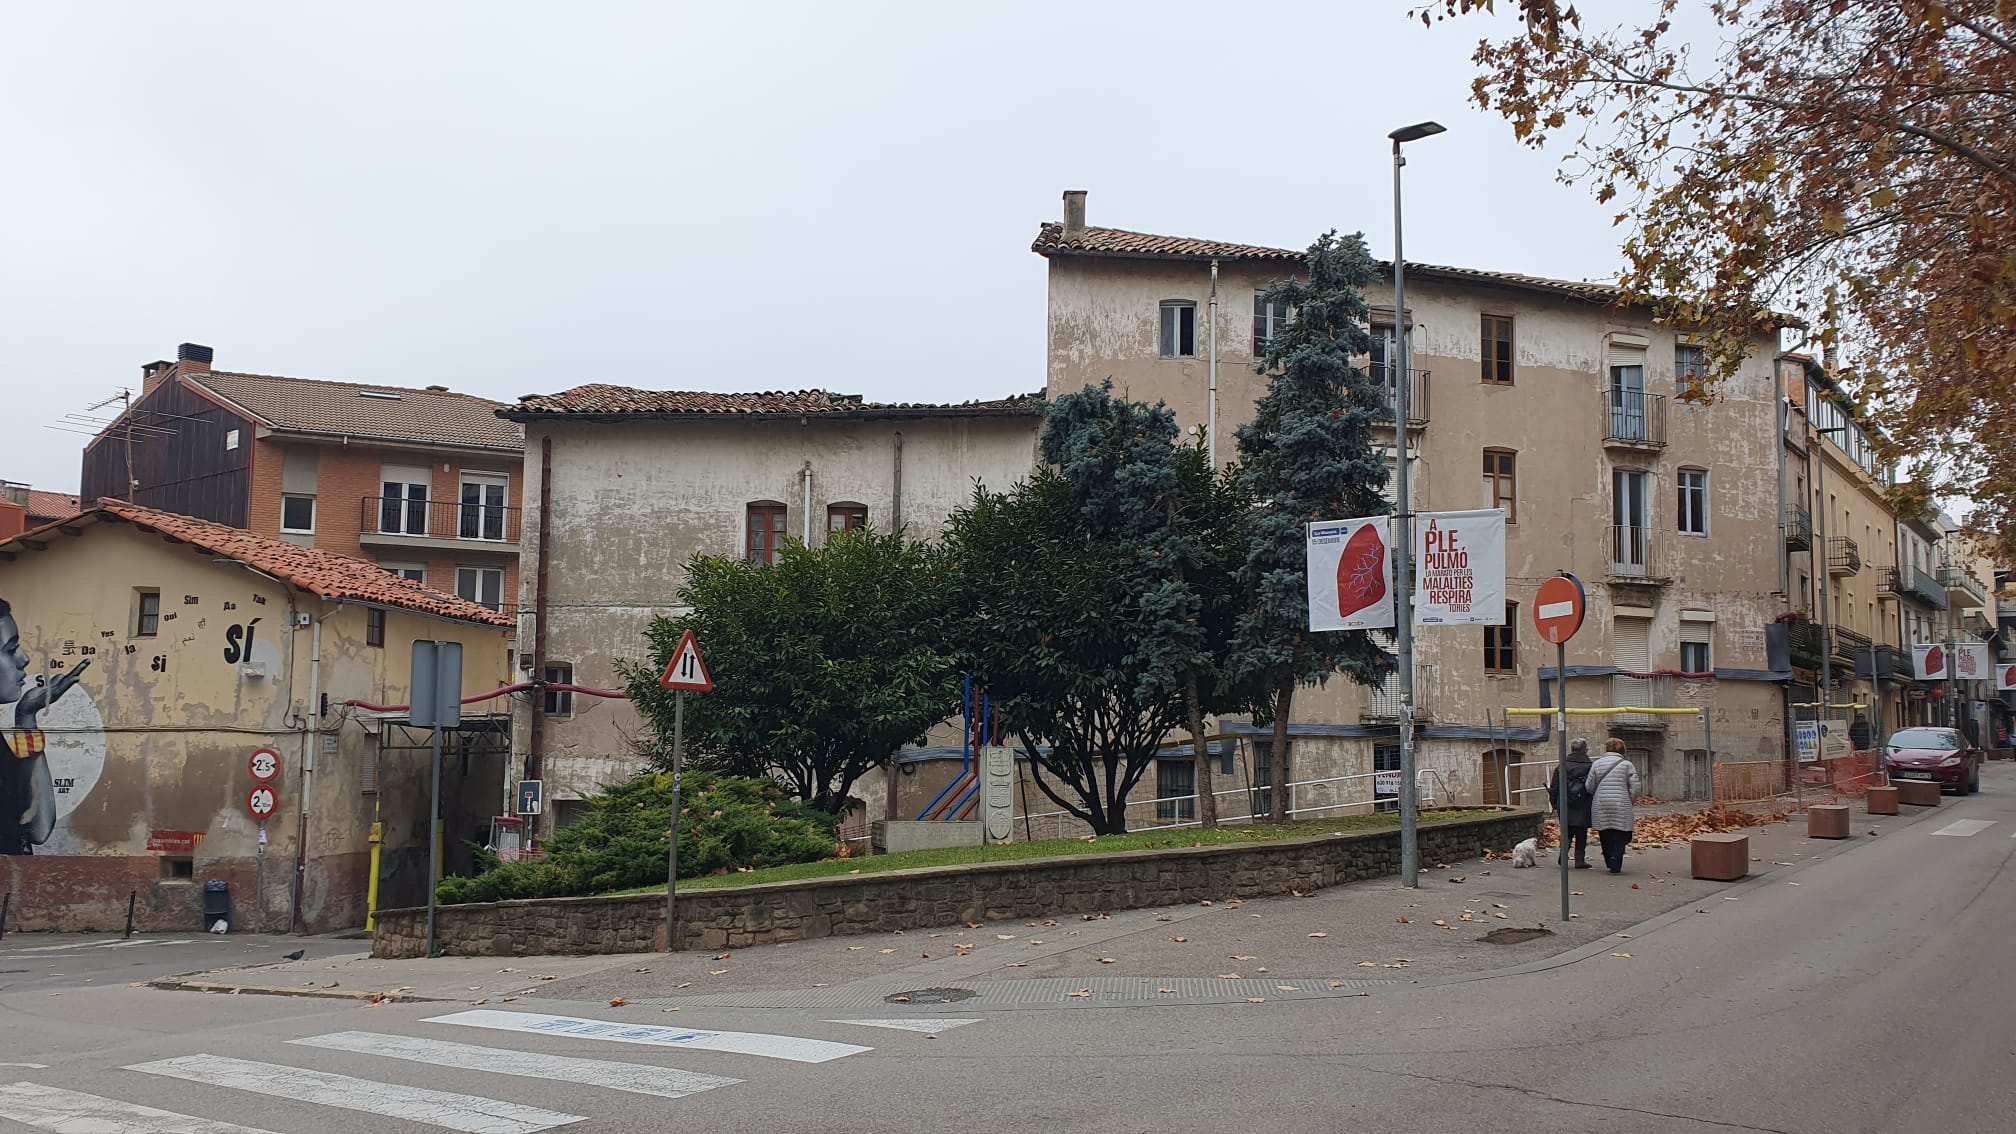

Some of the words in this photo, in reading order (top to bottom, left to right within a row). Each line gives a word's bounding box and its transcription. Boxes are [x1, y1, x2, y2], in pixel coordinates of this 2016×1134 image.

[1430, 518, 1437, 531] A
[1425, 530, 1458, 553] PLE
[1424, 546, 1468, 570] PULMÓ
[1453, 568, 1463, 576] PER
[1463, 568, 1473, 576] LES
[1423, 576, 1473, 590] MALALTIES
[184, 595, 198, 604] Sim
[1430, 590, 1472, 604] RESPIRA
[1449, 603, 1470, 613] TORIES
[101, 630, 115, 638] Yes
[81, 646, 96, 655] Da
[53, 778, 75, 788] SLIM
